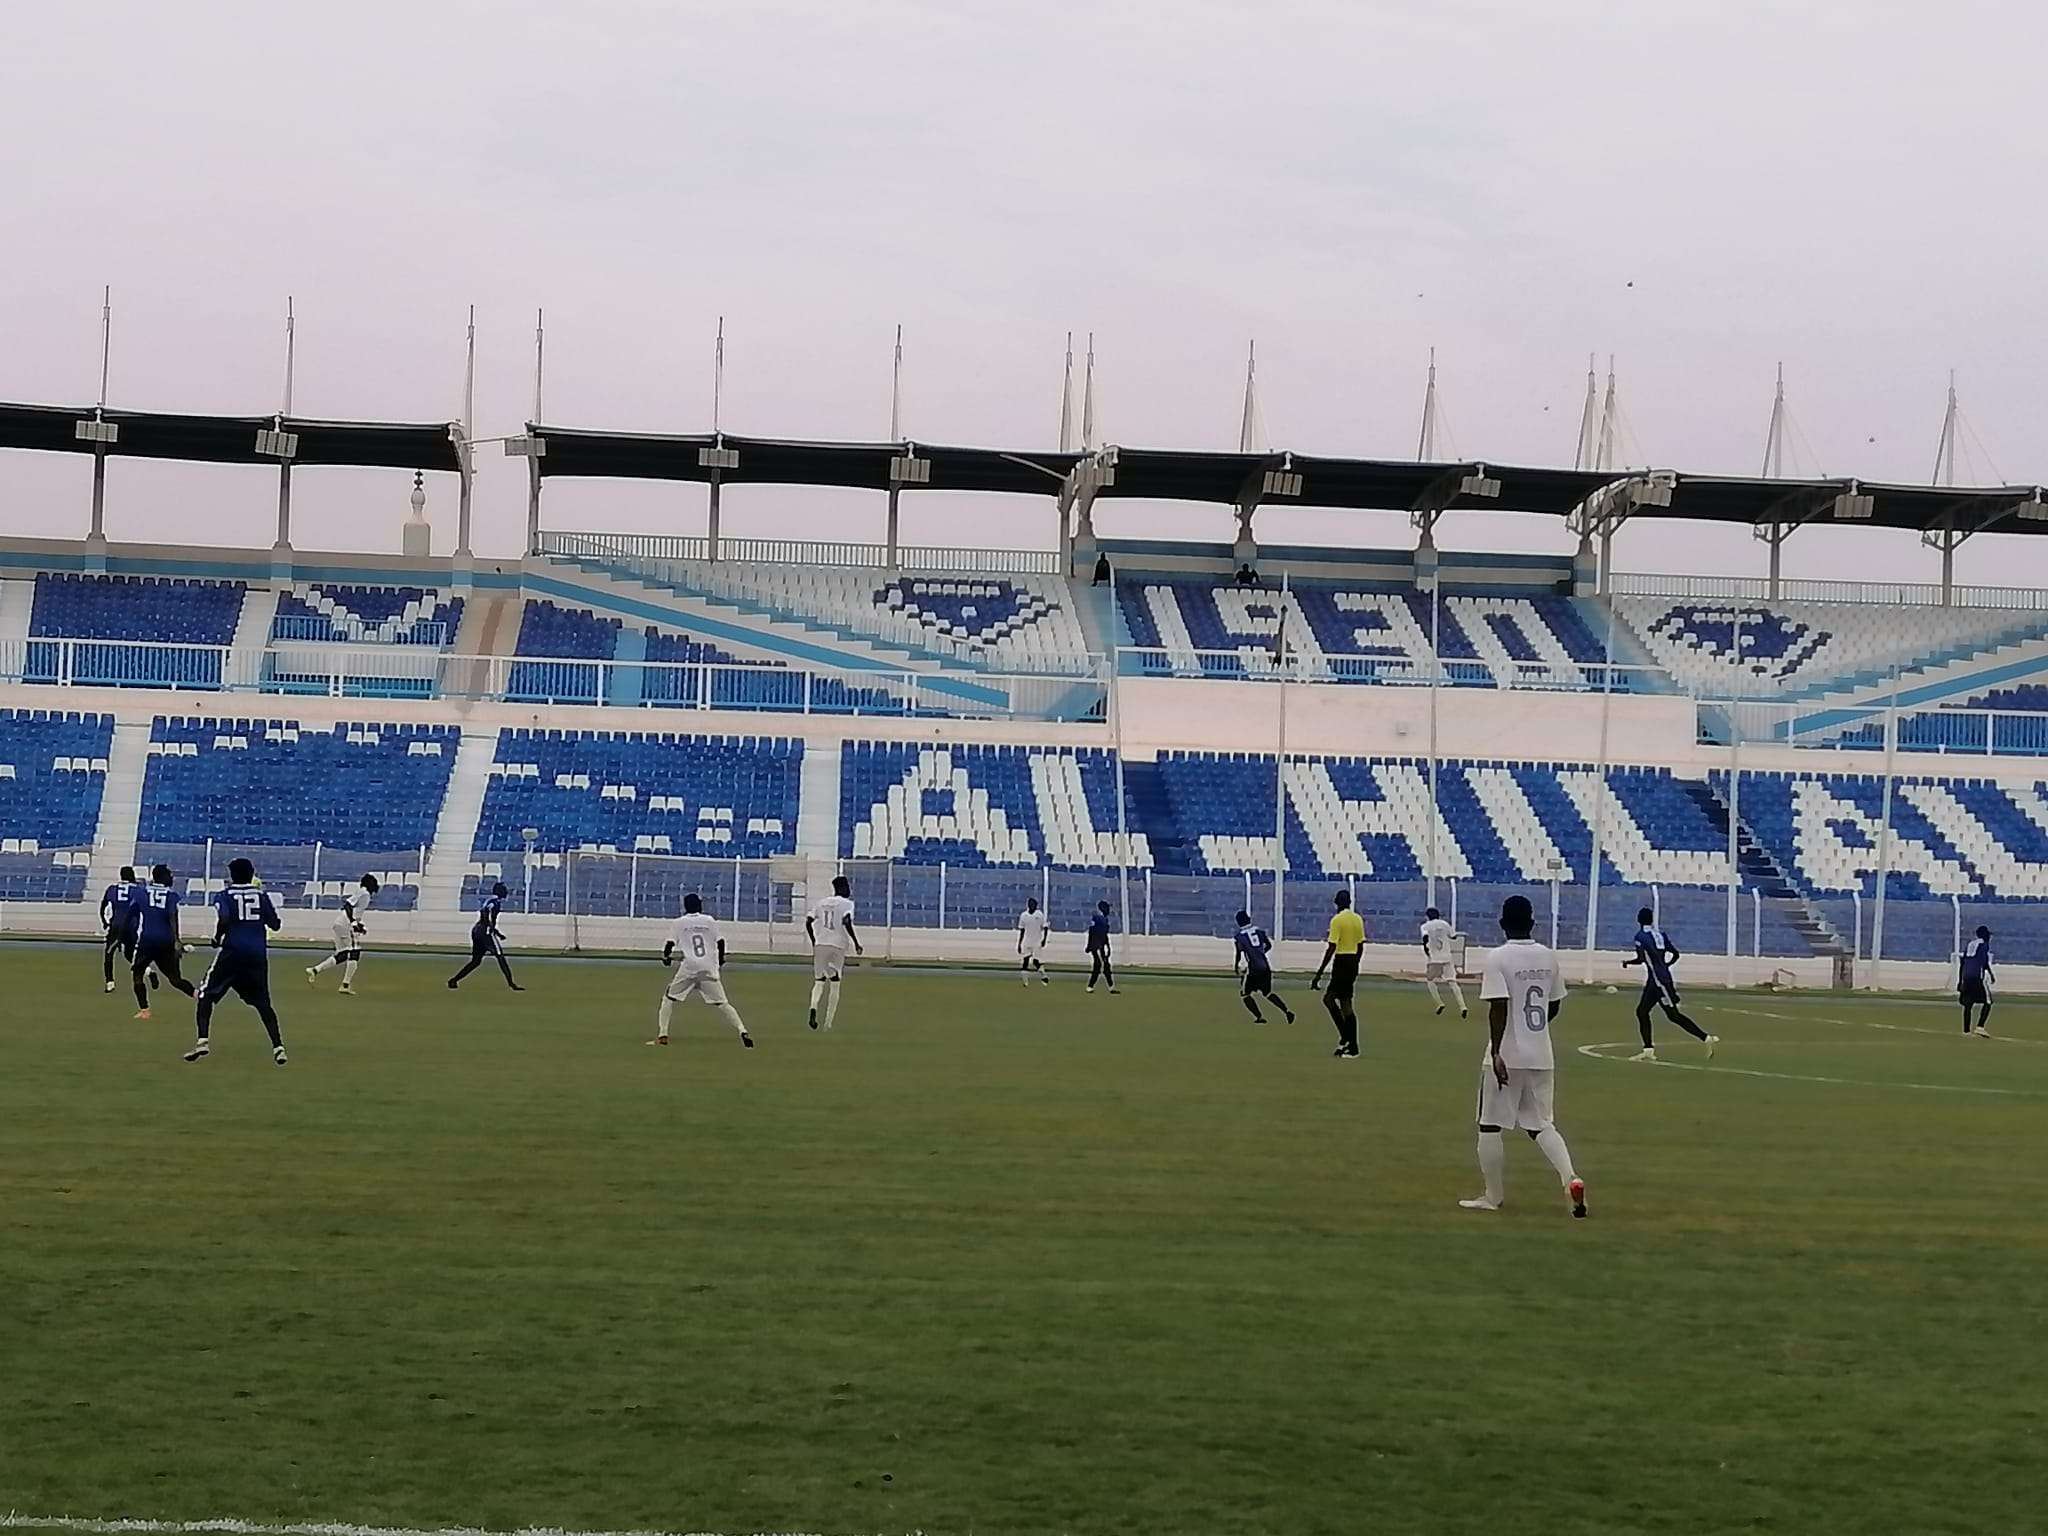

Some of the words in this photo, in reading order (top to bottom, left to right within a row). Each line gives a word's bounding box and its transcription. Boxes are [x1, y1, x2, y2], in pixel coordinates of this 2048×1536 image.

[1144, 585, 1592, 692] 1930
[117, 885, 129, 901] 2
[147, 889, 168, 909] 15
[233, 894, 261, 921] 12
[691, 934, 706, 958] 8
[1523, 985, 1547, 1032] 6
